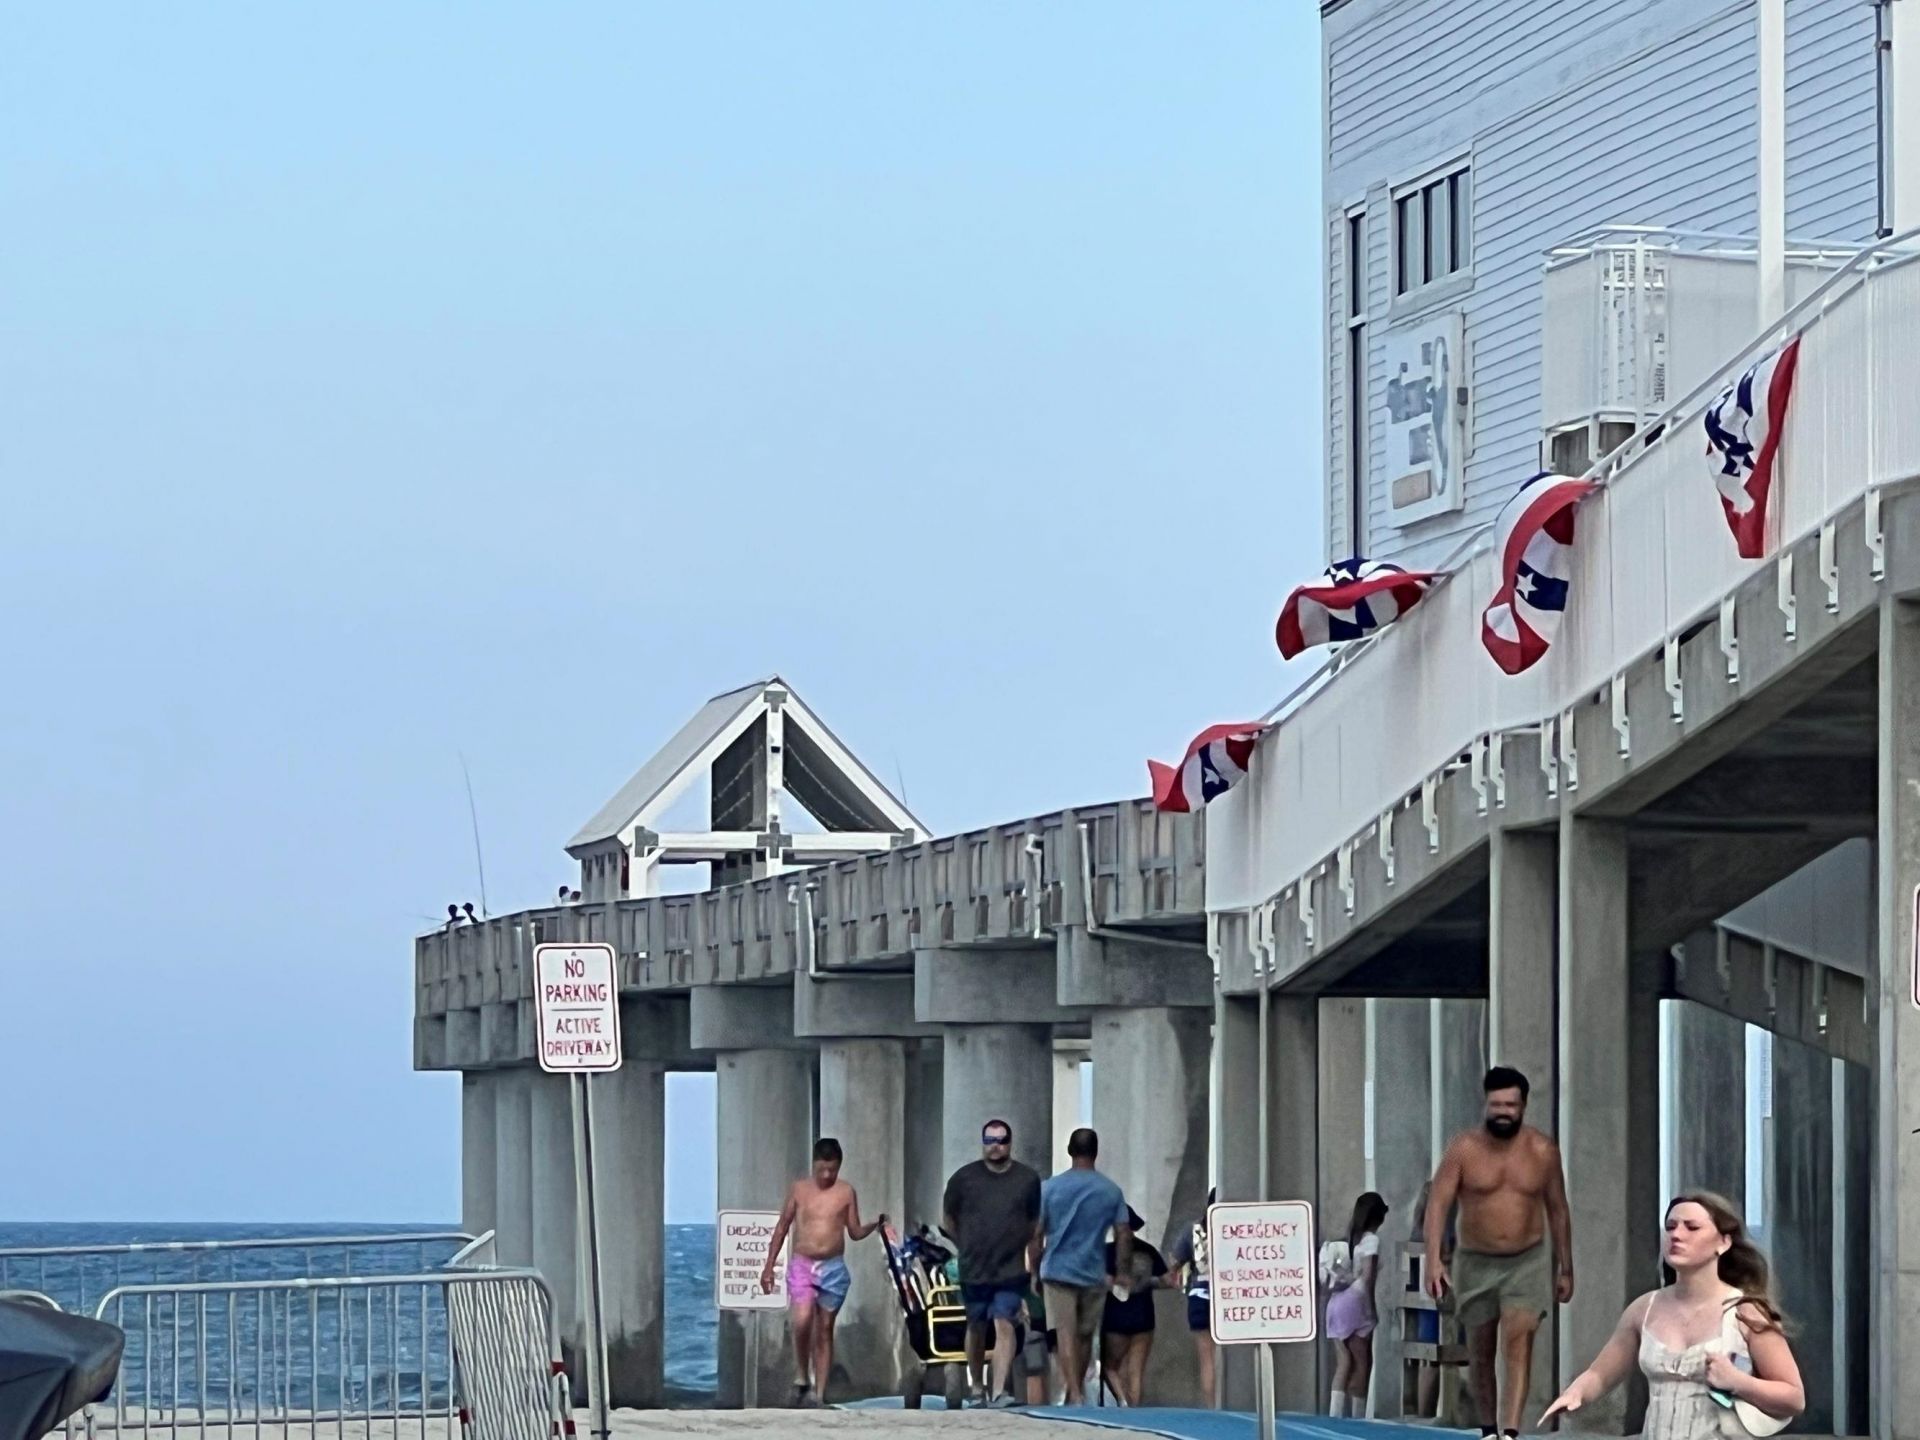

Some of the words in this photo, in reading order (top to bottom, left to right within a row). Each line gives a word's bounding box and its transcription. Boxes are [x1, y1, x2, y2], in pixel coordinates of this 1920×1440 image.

[565, 959, 585, 978] NO
[546, 984, 607, 1002] PARKING
[556, 1018, 602, 1034] ACTIVE
[546, 1039, 611, 1057] DRIVEWAY
[1222, 1223, 1298, 1239] EMERGENCY
[736, 1241, 767, 1252] ACCES
[1236, 1245, 1286, 1261] ACCESS
[1219, 1270, 1234, 1281] NO
[1237, 1268, 1304, 1281] SUNBATHING
[1220, 1287, 1269, 1300] BETWEEN
[1273, 1285, 1304, 1298] SIGNS
[1223, 1306, 1256, 1322] KEEP
[1261, 1305, 1303, 1320] CLEAR
